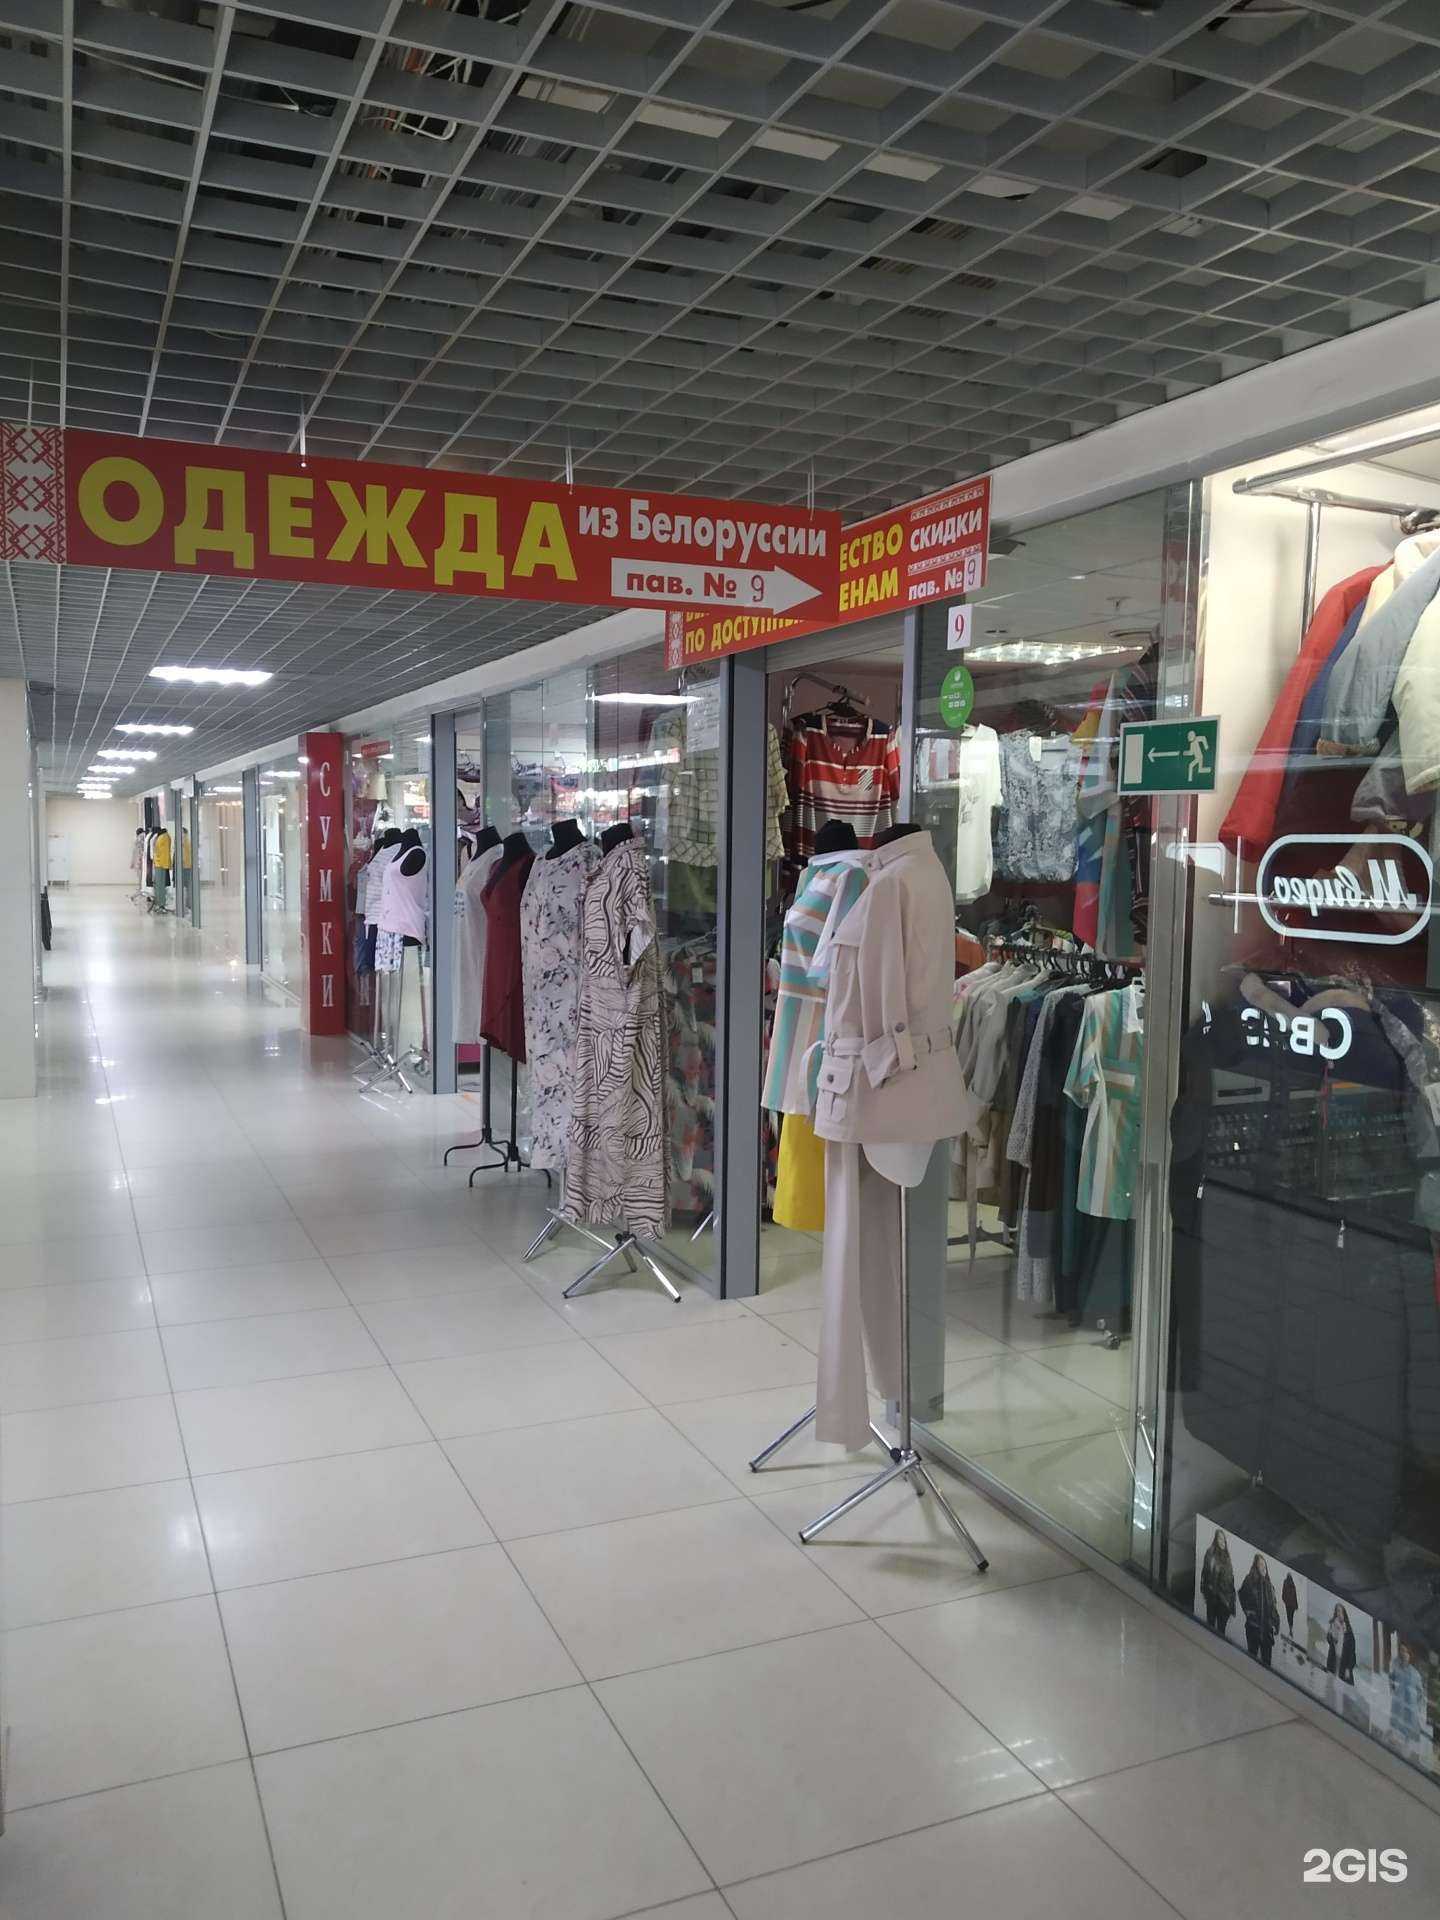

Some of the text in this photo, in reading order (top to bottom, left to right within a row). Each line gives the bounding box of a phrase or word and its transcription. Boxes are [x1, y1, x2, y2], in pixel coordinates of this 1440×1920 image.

[77, 456, 578, 590] ОДЕЖДА
[578, 498, 827, 564] из Белоруссии
[910, 507, 983, 552] СКИДКИ
[839, 523, 904, 572] ЕСТВО
[626, 572, 765, 603] пав. № 9
[839, 567, 899, 612] ЕНАМ
[908, 580, 940, 601] пав.
[944, 567, 963, 591] №
[684, 627, 705, 655] ПО
[954, 613, 965, 642] 9
[319, 761, 334, 1008] СУМКИ
